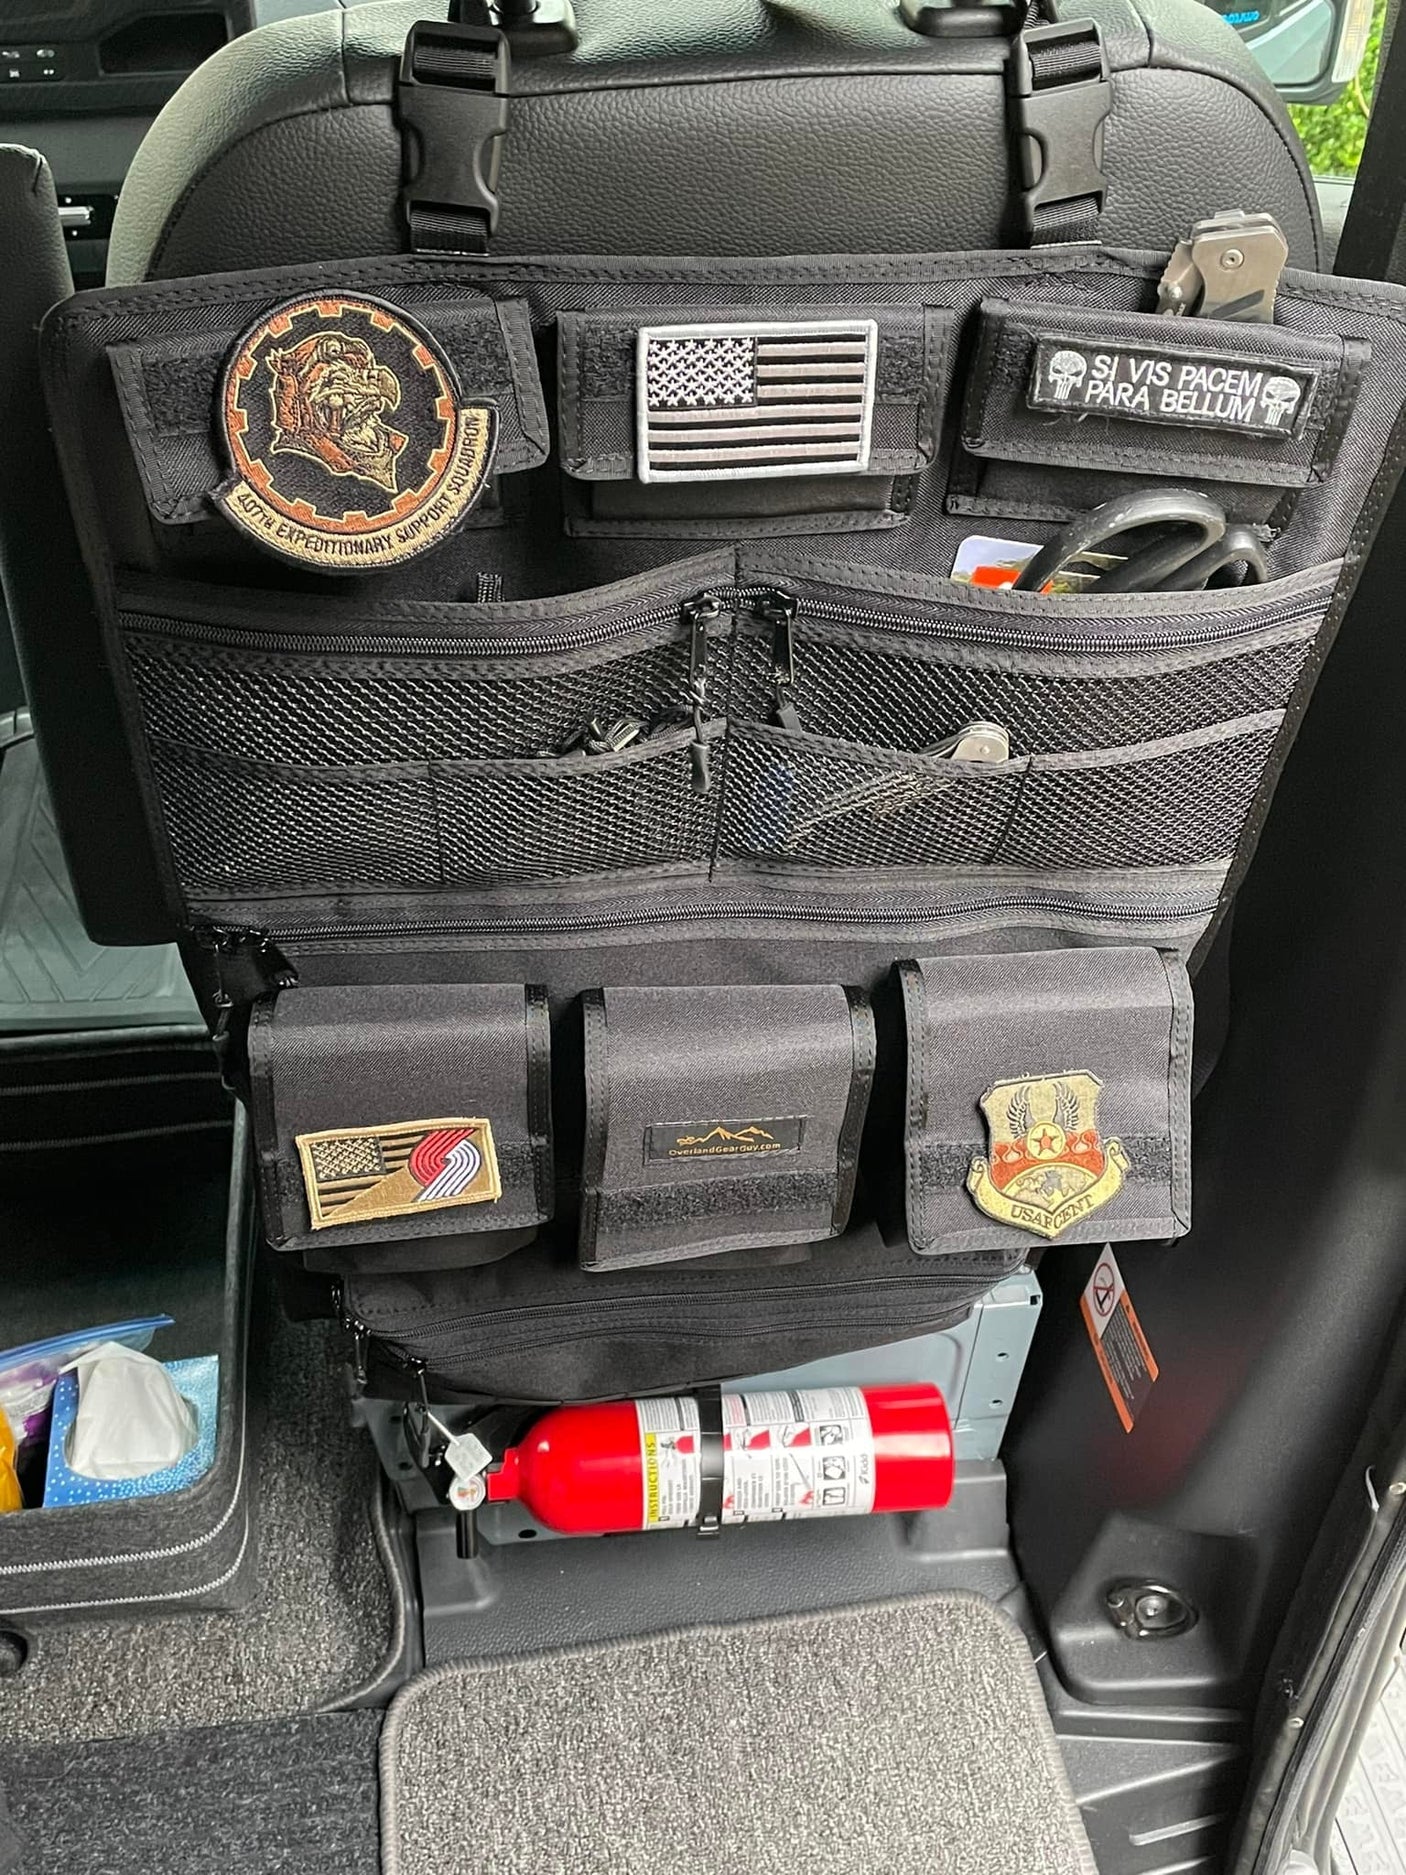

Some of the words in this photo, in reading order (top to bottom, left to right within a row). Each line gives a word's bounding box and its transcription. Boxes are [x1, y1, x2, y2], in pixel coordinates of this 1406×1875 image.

[1091, 354, 1119, 382] SI
[1129, 357, 1171, 386] VIS
[1179, 365, 1264, 397] PACEM
[1085, 380, 1149, 411] PARA
[1161, 389, 1256, 423] BELLUM
[237, 492, 274, 529] 407TH
[276, 523, 396, 556] EXPEDITIONARY
[397, 492, 452, 542] SUPPORT
[447, 413, 481, 495] SQUADRON
[668, 1142, 782, 1156] OverlandGearGuy.com
[647, 1442, 660, 1519] INSTRUCTIONS
[859, 1454, 869, 1476] Kidd
